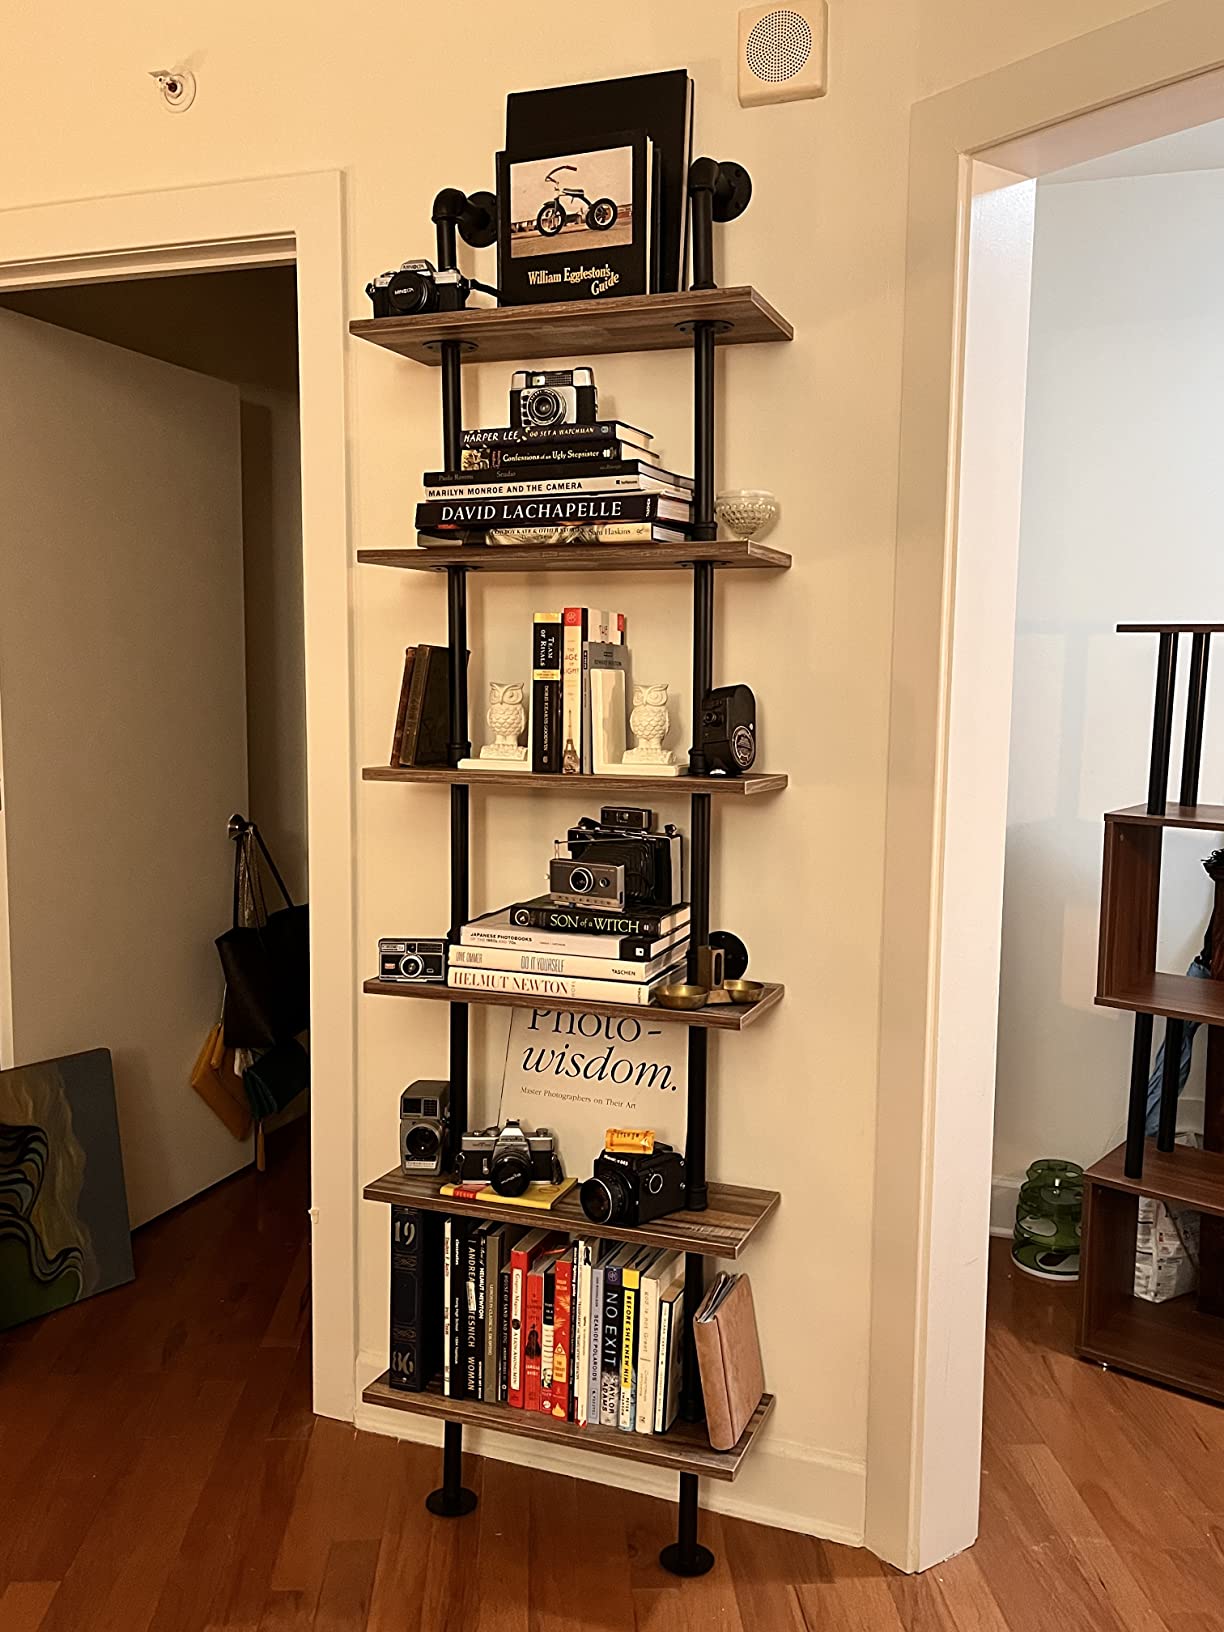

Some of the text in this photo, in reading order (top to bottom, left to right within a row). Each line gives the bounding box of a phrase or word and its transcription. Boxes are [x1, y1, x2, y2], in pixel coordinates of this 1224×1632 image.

[528, 264, 612, 285] William Eggleston's
[591, 272, 620, 296] Guide
[463, 432, 499, 443] HARPER
[503, 429, 519, 441] LEE
[559, 427, 595, 435] WATCHMAN
[502, 453, 540, 462] Confessions
[552, 450, 567, 460] Ugly
[567, 449, 600, 459] Stepsister
[428, 481, 583, 497] MARILYN MONROE AND THE CAMERA
[442, 501, 622, 521] DAVID LACHAPELLE
[604, 527, 631, 535] Haskins
[540, 640, 548, 667] RIVALS
[547, 636, 555, 659] TEAM
[550, 914, 579, 928] SON
[580, 918, 588, 928] of
[593, 917, 640, 933] WITCH
[497, 934, 532, 942] PHOTOBOOKS
[521, 956, 565, 972] DO IT YOURSELF
[611, 968, 636, 976] TASCHEN
[454, 971, 568, 995] HELMUT NEWTON
[522, 1043, 677, 1092] wisdom.
[521, 1086, 542, 1096] Master
[543, 1089, 592, 1104] Photographers
[605, 1098, 624, 1108] Their
[625, 1101, 637, 1110] Art
[394, 1220, 416, 1246] 19
[604, 1292, 618, 1367] NO EXIT
[467, 1356, 475, 1391] WOMAN
